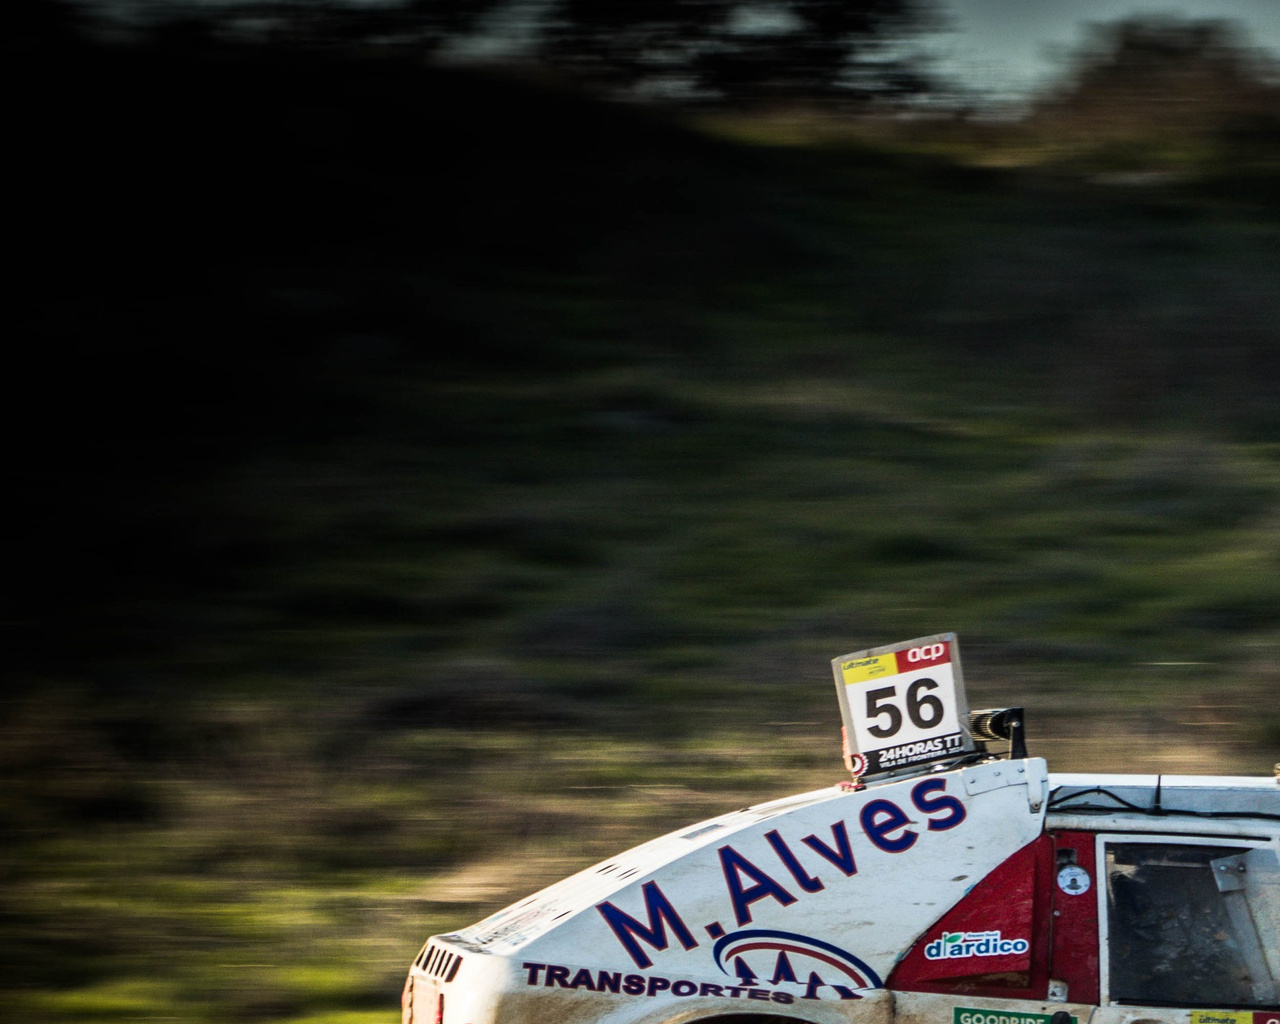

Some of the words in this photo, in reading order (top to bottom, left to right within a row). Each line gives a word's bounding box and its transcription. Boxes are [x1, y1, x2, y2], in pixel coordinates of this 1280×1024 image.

[907, 643, 944, 663] acp
[865, 677, 944, 739] 56
[943, 734, 962, 748] TT
[523, 962, 794, 1005] TRANSPORTES
[1199, 1016, 1236, 1024] ultimate
